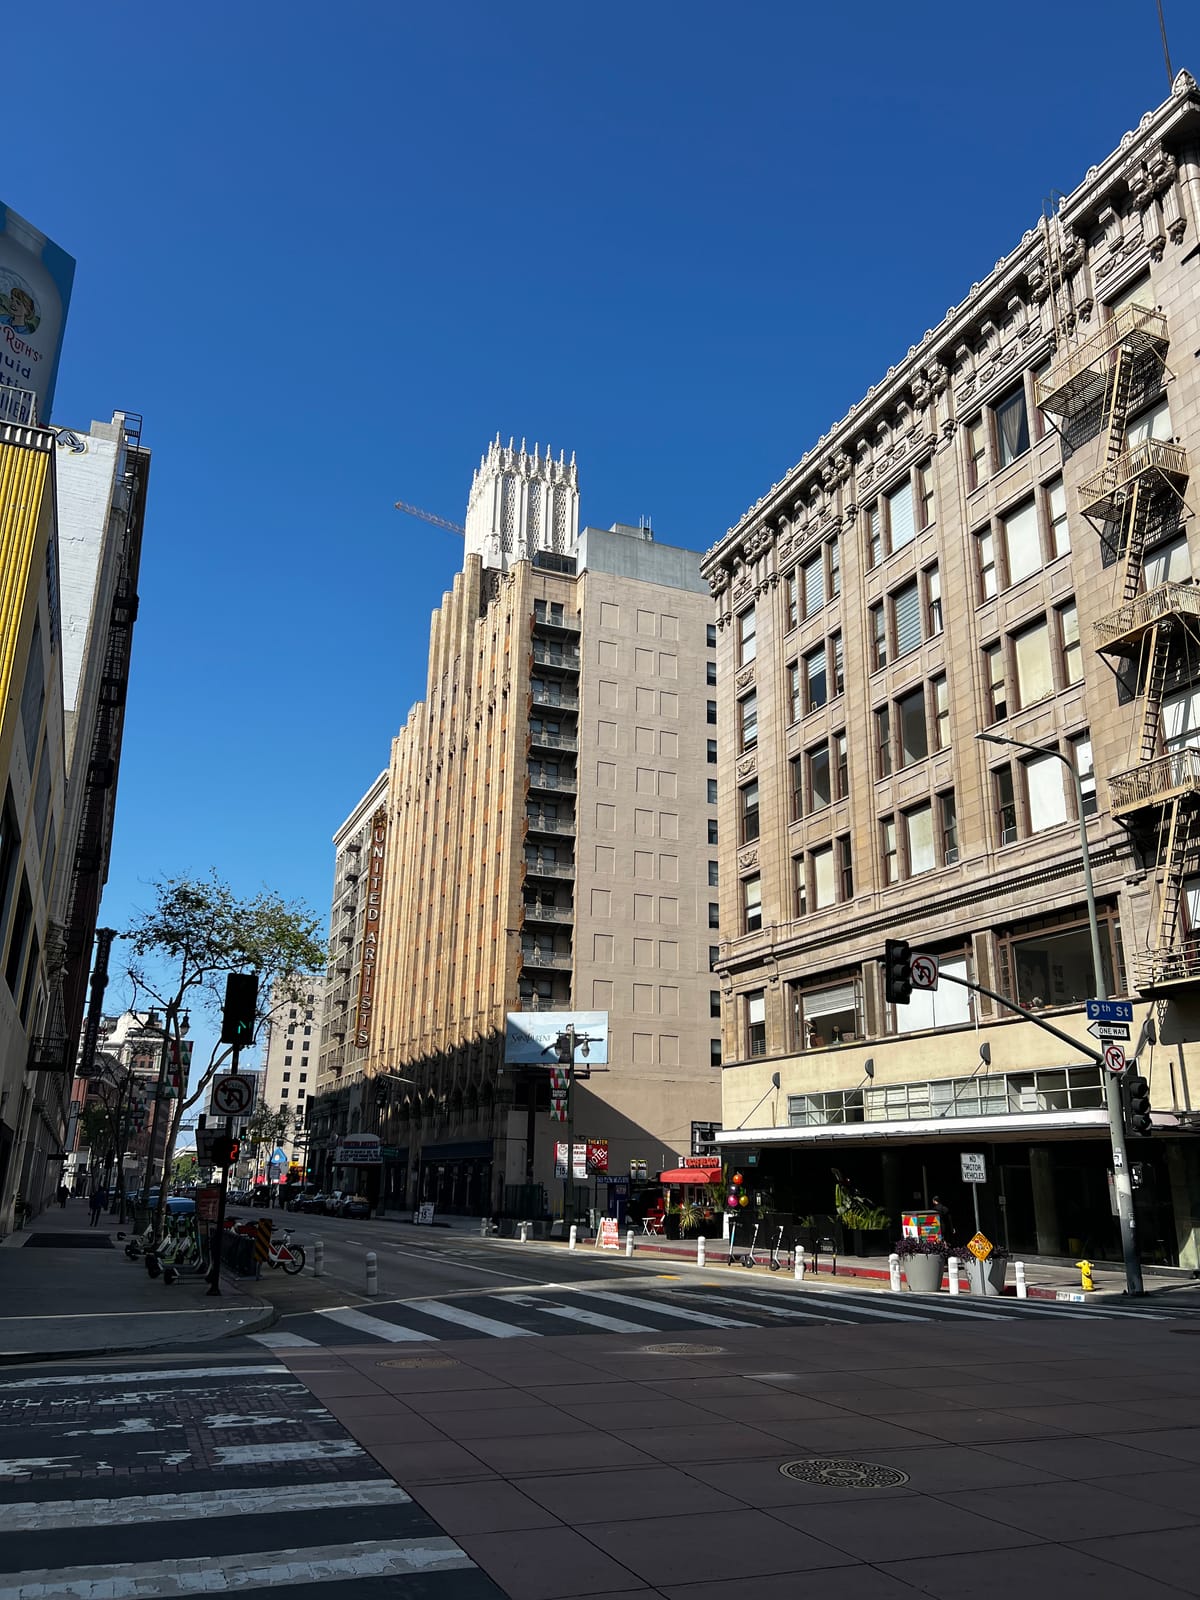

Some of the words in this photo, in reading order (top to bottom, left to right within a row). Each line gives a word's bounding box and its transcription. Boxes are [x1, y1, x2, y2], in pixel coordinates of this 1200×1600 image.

[368, 829, 386, 923] UNITED
[358, 934, 377, 1045] ARTISTS
[1090, 1003, 1111, 1017] 9th
[1115, 1006, 1129, 1017] St
[1099, 1027, 1112, 1035] ONE
[1112, 1028, 1125, 1036] WAY
